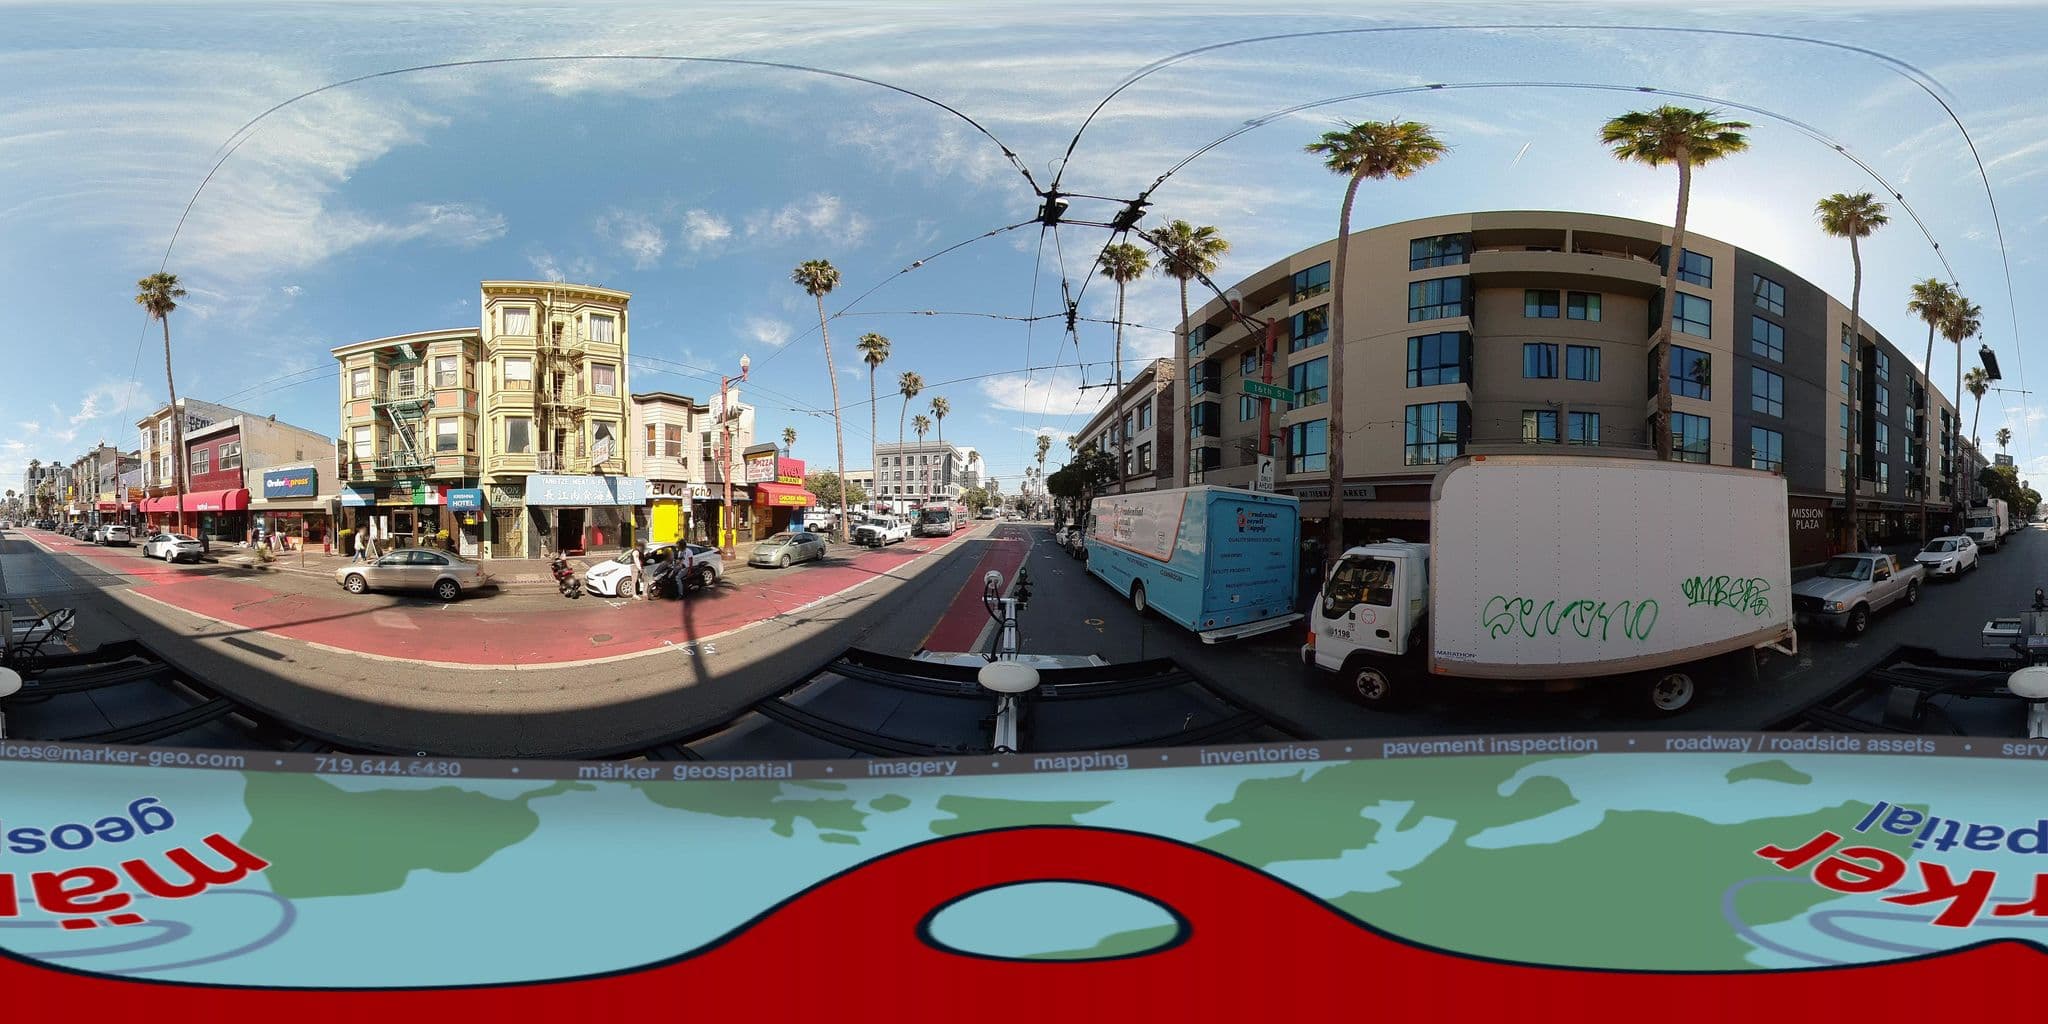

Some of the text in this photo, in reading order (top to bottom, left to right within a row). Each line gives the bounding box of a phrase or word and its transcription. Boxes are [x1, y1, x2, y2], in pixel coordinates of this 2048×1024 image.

[1254, 384, 1286, 399] 16th St
[652, 484, 665, 496] El
[1342, 489, 1368, 497] ARKET
[1791, 508, 1824, 519] MISSION
[1795, 519, 1820, 530] PLAZA
